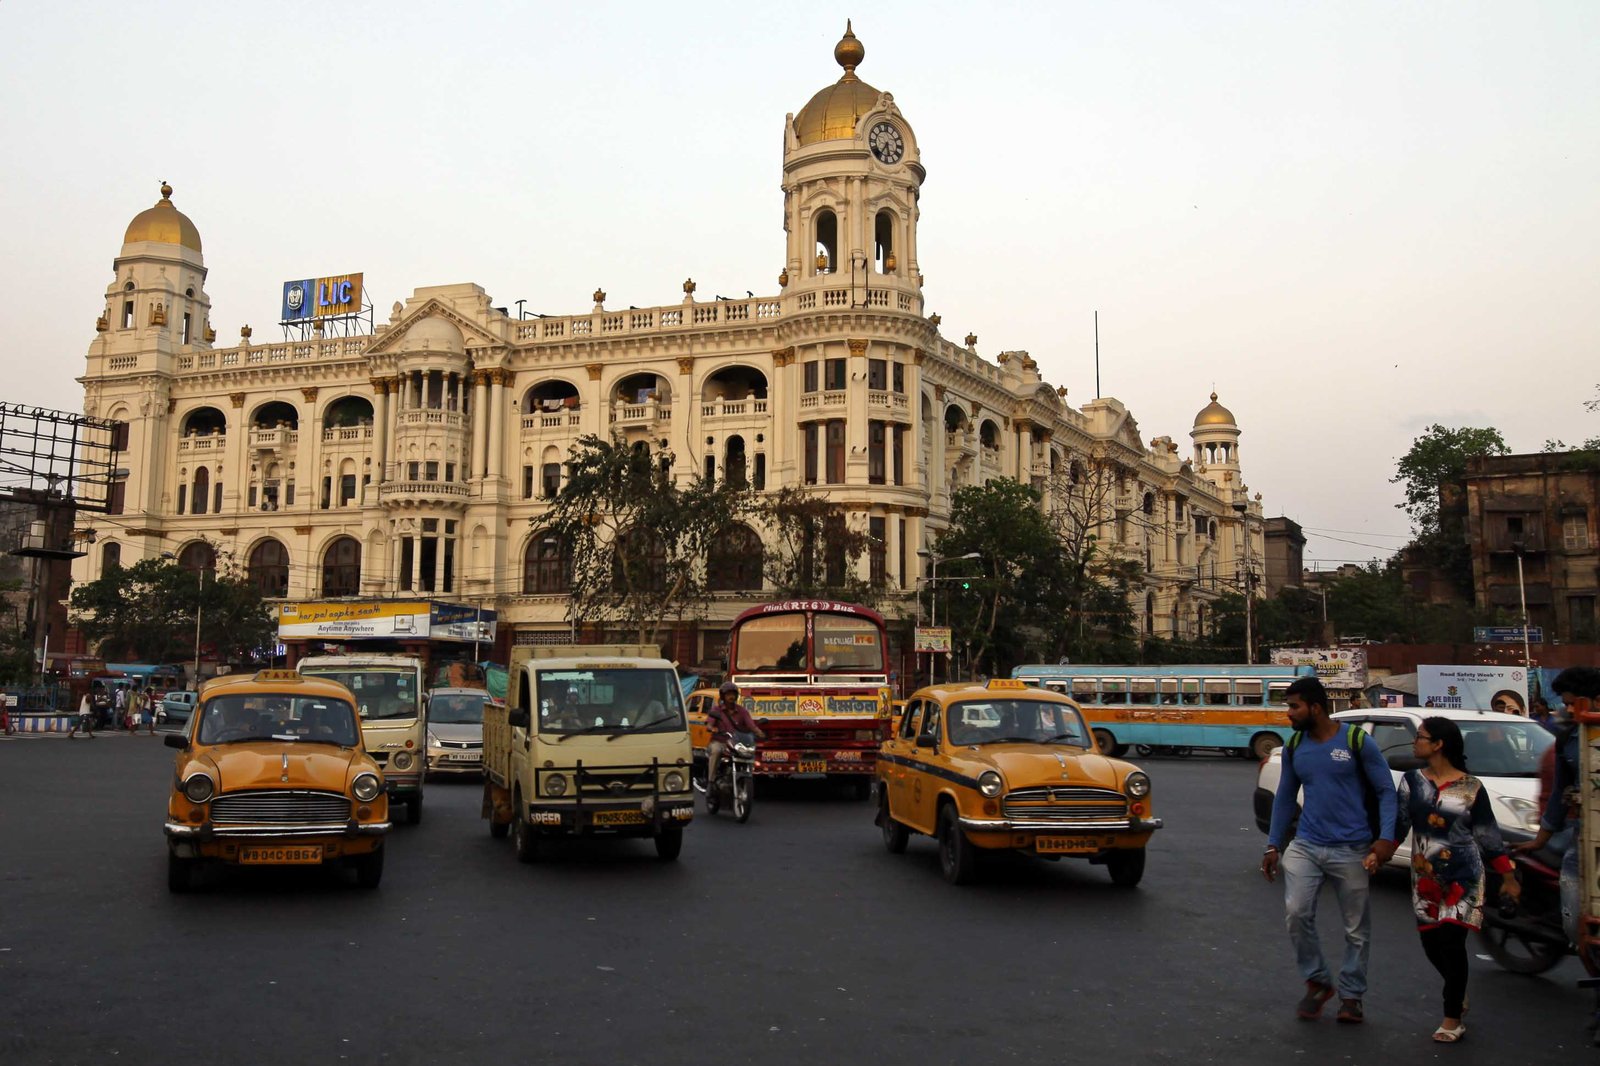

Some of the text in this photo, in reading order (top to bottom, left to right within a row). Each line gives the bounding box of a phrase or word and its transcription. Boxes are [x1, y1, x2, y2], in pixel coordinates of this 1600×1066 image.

[319, 281, 351, 306] LIC
[298, 610, 310, 620] har
[312, 609, 327, 622] pal
[318, 625, 375, 633] Anytime Anywhere
[1427, 695, 1442, 703] SAFE
[531, 812, 561, 825] SPEED
